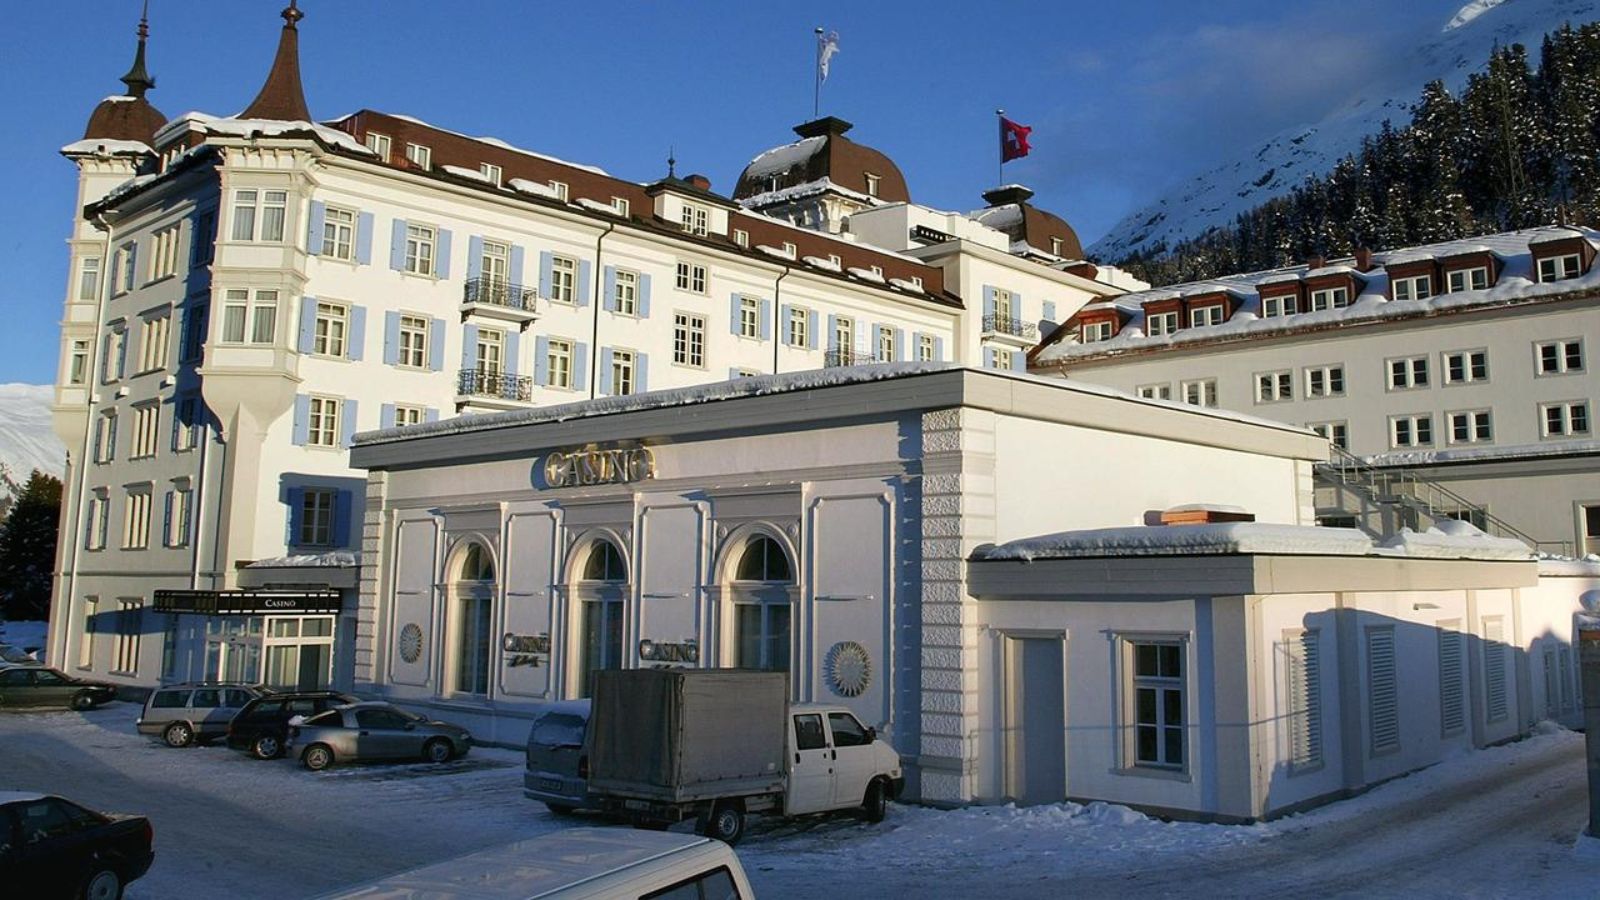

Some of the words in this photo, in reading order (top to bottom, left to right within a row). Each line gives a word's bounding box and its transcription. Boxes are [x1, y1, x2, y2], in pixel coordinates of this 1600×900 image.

[544, 446, 655, 487] CASINO
[264, 599, 297, 608] CASINO
[639, 639, 699, 662] CASINO
